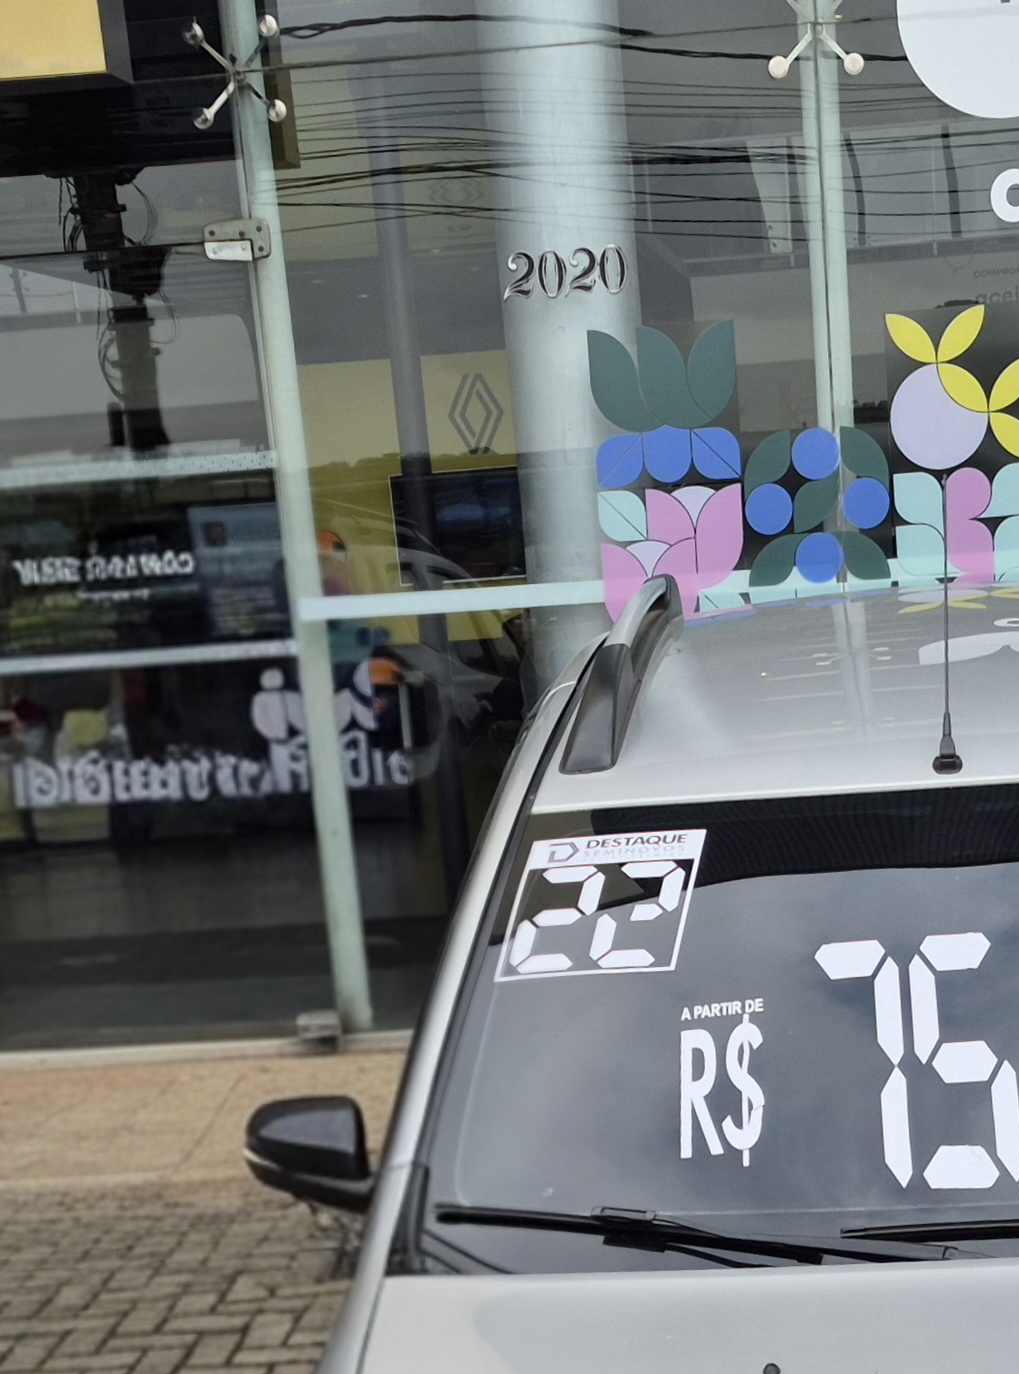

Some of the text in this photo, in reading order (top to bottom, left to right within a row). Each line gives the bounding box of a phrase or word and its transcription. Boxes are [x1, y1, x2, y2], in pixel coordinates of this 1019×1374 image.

[503, 244, 628, 302] 2020
[583, 845, 685, 858] SEMINOVOS
[585, 833, 688, 849] DESTAQUE
[509, 860, 686, 975] 22
[680, 997, 764, 1021] A PARTIR DE
[680, 1013, 765, 1167] R$
